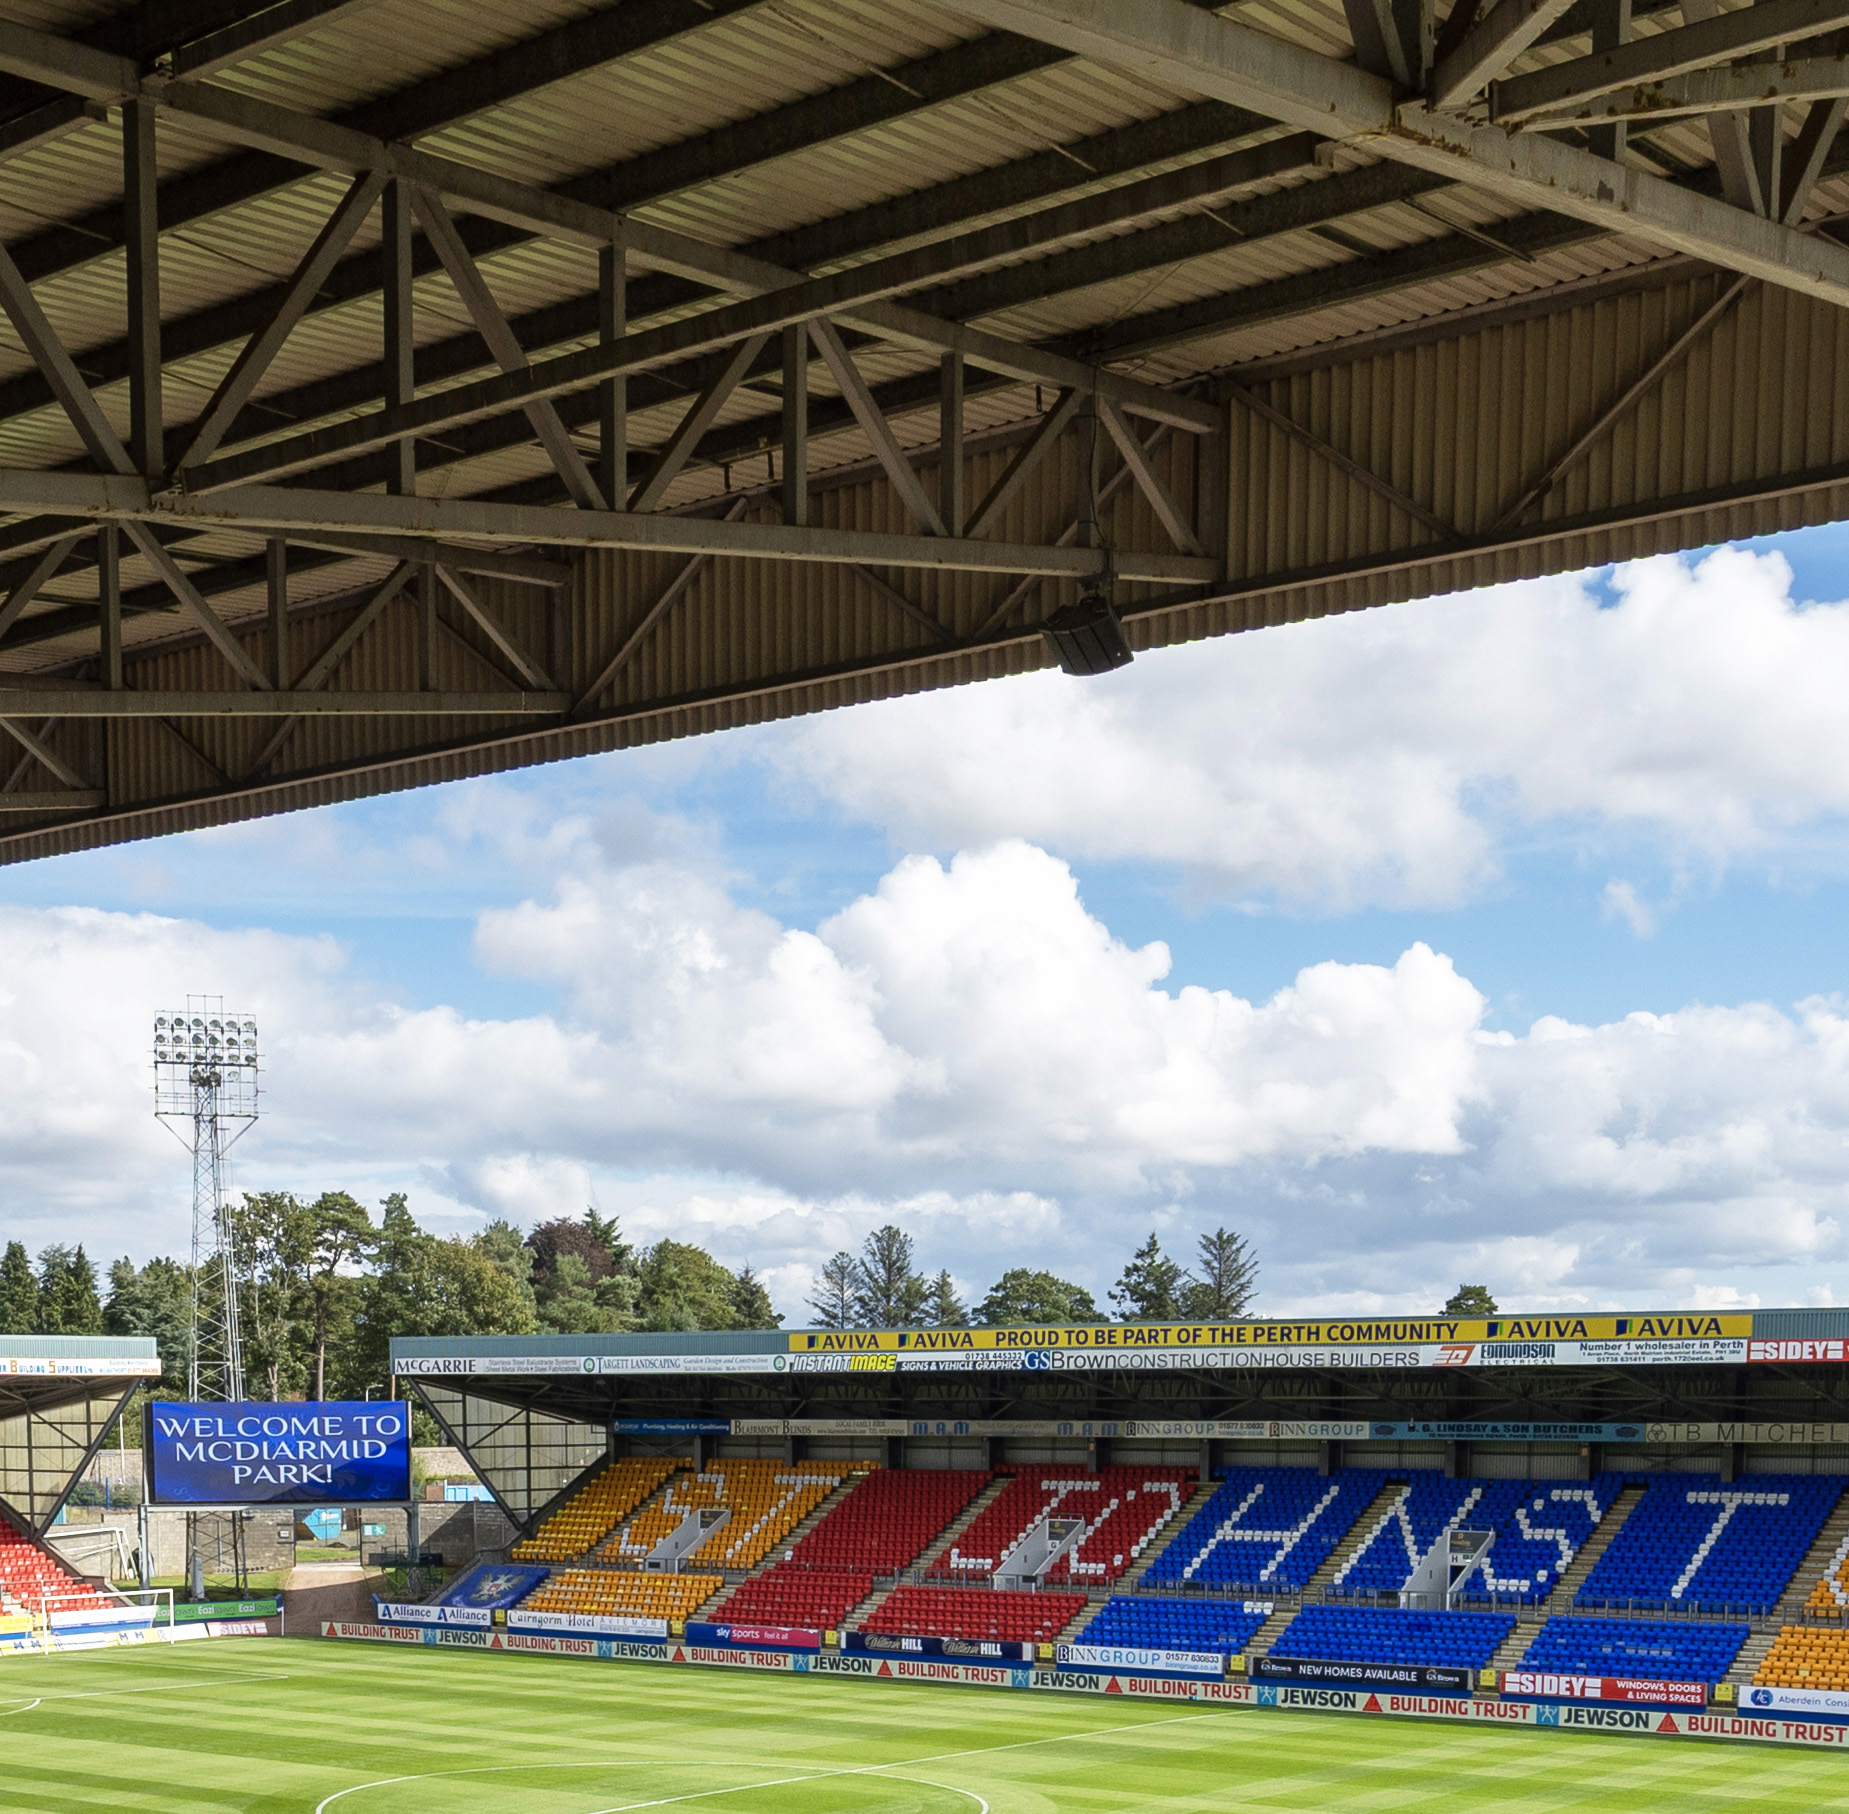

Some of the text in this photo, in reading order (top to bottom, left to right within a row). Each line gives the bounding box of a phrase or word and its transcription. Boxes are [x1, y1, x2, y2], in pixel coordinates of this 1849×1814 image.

[995, 1323, 1459, 1346] PROUD TO BE PART OF THE PERTH COMMUNITY
[1508, 1318, 1723, 1338] AVIVA AVIVA
[822, 1332, 974, 1349] AVIVA AVIVA
[1580, 1342, 1622, 1351] Number
[1627, 1342, 1630, 1350] 1
[1635, 1341, 1695, 1350] wholesaler
[1699, 1341, 1709, 1349] in
[1713, 1341, 1743, 1349] Perth
[901, 1360, 1023, 1371] SIGNS & VEHICLE GRAPHICS
[156, 1415, 401, 1438] WELCOME TO
[734, 1420, 780, 1435] BLAIRMONT
[782, 1420, 812, 1435] BLINDS
[175, 1439, 386, 1463] MCDIARMID
[232, 1464, 333, 1485] PARK!
[394, 1606, 488, 1622] Alliance Alliance
[509, 1611, 595, 1627] Cairngorm Hotel
[341, 1623, 420, 1640] BUILDING TRUST
[438, 1631, 486, 1646] JEWSON
[716, 1628, 730, 1639] sky
[732, 1630, 760, 1640] sports
[508, 1635, 594, 1653] BUILDING TRUST
[614, 1642, 667, 1658] JEWSON
[901, 1638, 922, 1651] HILL
[898, 1662, 1007, 1683] BUILDING TRUST
[1033, 1671, 1099, 1689] JEWSON
[1299, 1665, 1320, 1676] NEW
[1324, 1667, 1362, 1679] HOMES
[1364, 1668, 1417, 1682] AVAILABLE
[1129, 1679, 1252, 1700] BUILDING TRUST
[1281, 1688, 1357, 1708] JEWSON
[1390, 1697, 1530, 1719] BUILDING TRUST
[1779, 1695, 1821, 1706] Aberdein
[1564, 1708, 1649, 1729] JEWSON
